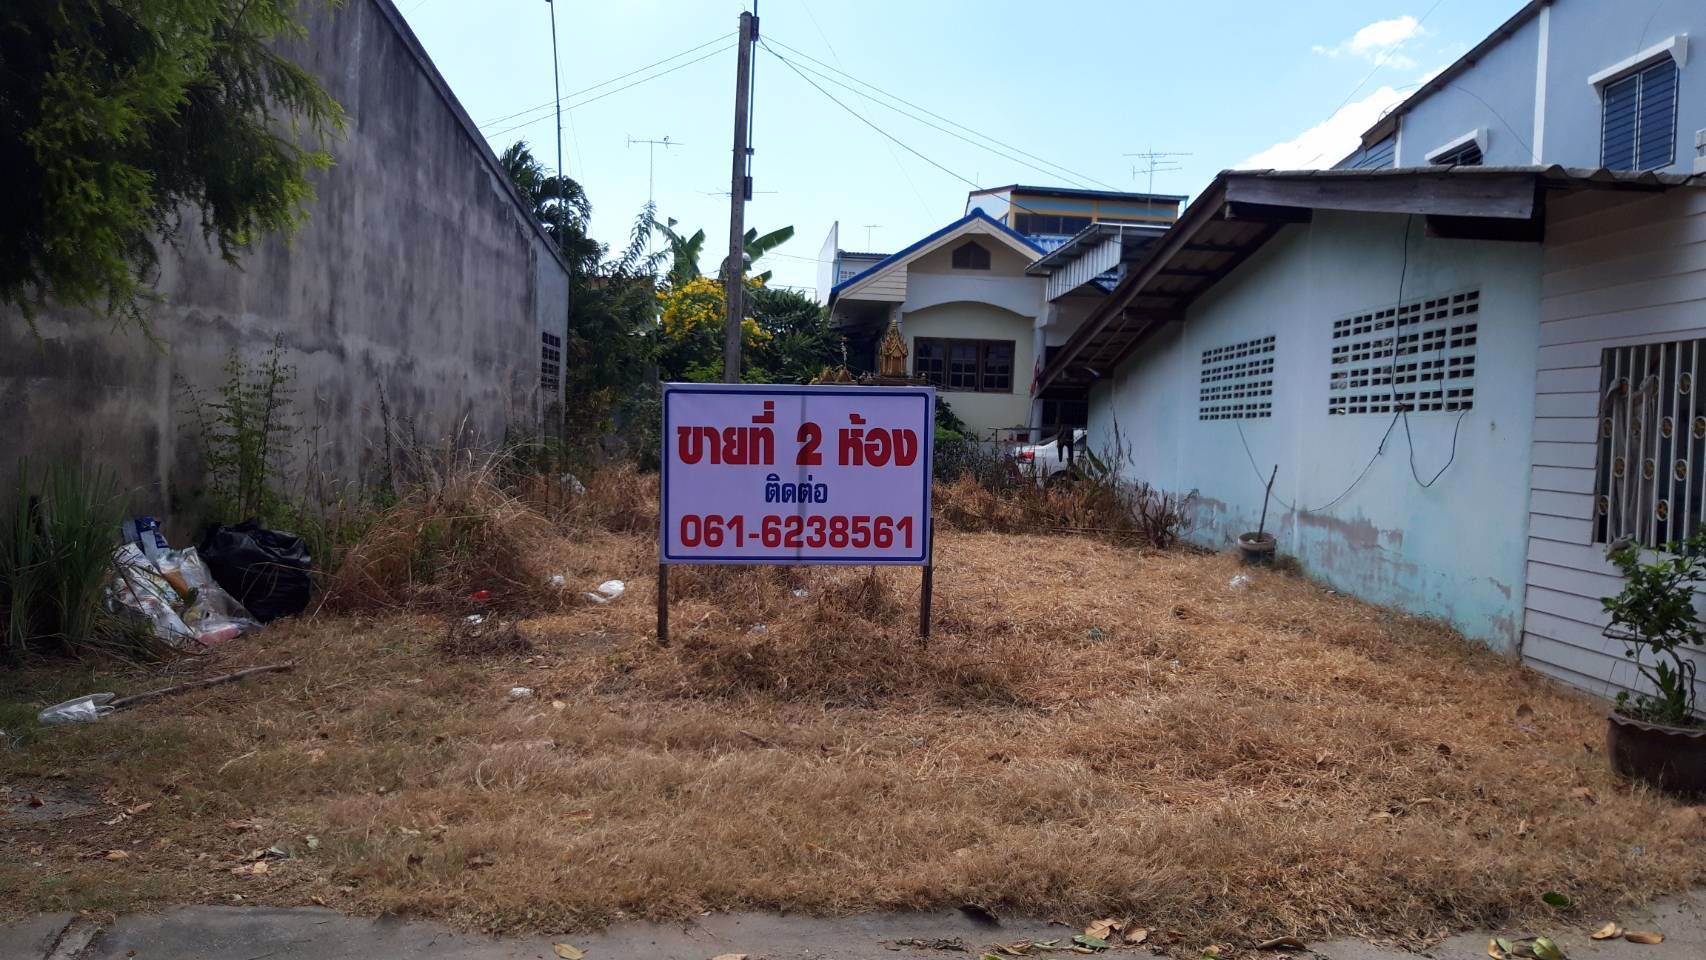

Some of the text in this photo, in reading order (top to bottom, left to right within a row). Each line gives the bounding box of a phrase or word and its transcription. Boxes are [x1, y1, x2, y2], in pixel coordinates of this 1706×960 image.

[677, 400, 918, 467] ขายที่ 2 ห้อง
[765, 473, 828, 504] ติดต่อ
[680, 514, 913, 549] 061-6238561
